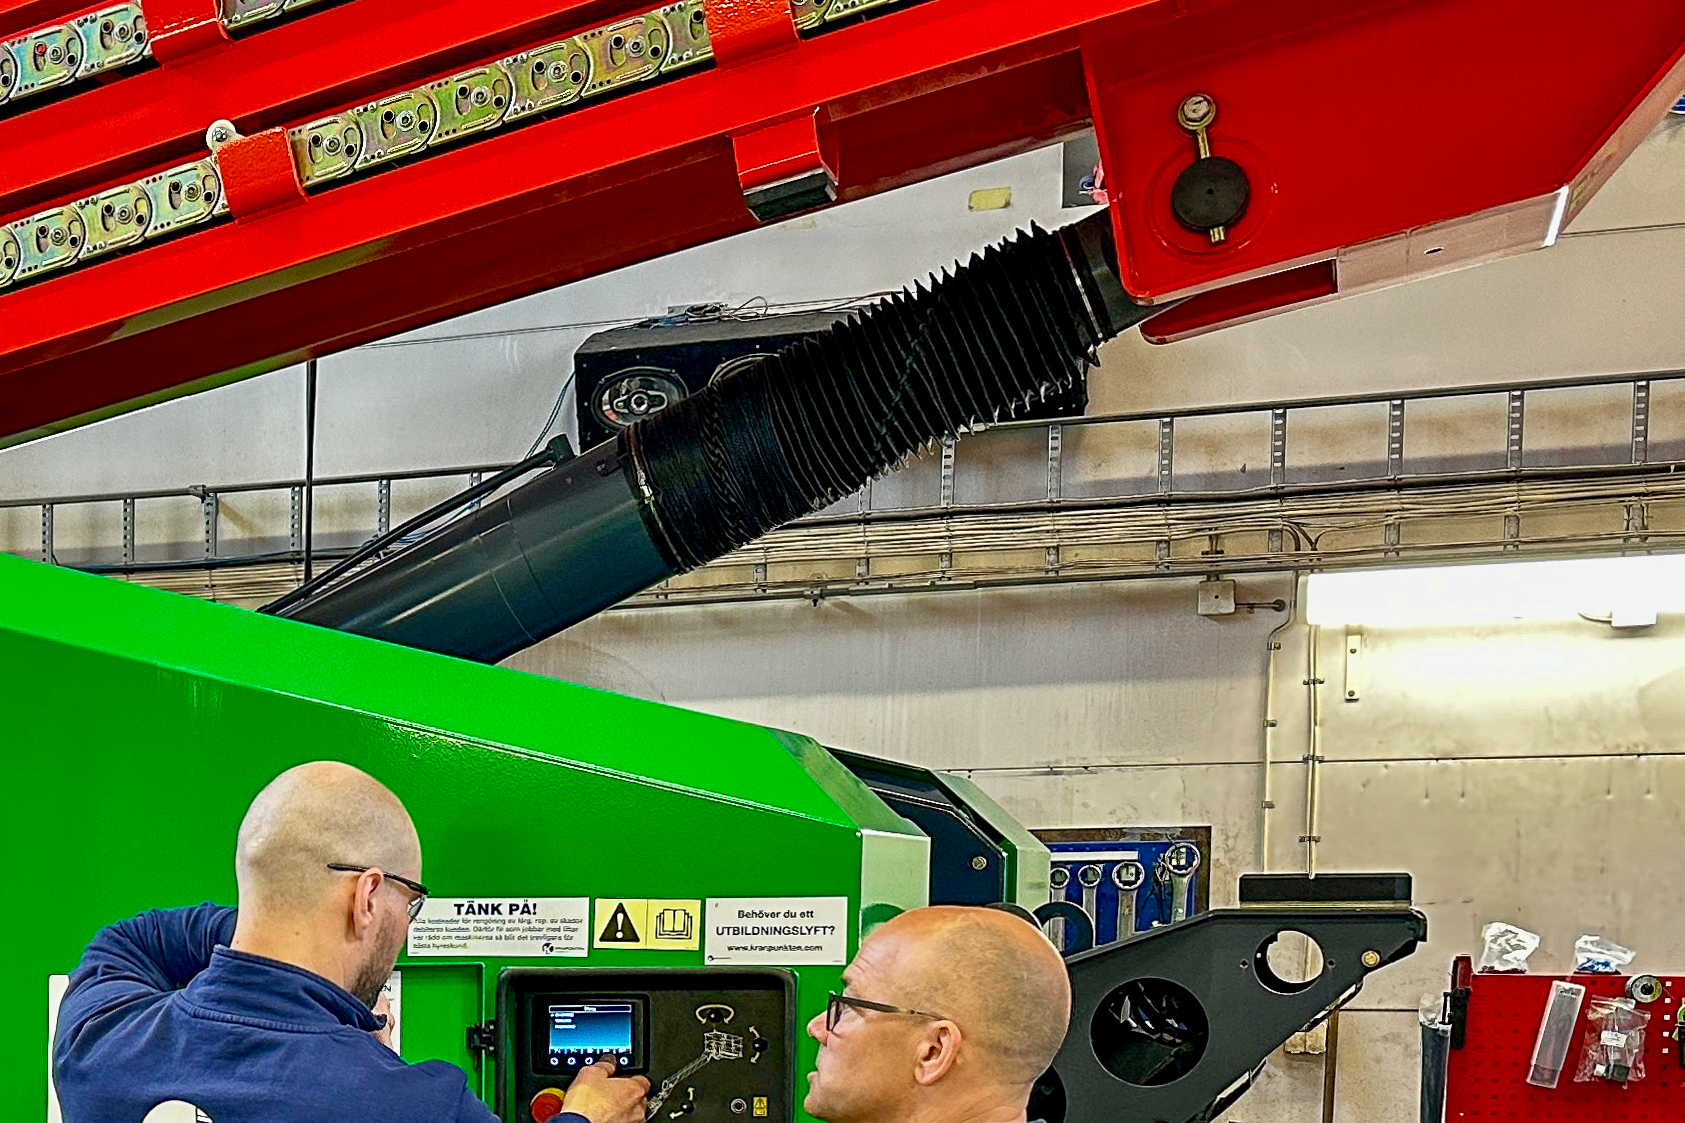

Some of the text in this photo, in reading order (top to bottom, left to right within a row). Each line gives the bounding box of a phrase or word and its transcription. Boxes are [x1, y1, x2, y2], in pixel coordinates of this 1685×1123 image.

[453, 899, 538, 916] TÄNK PÅ!
[737, 909, 815, 919] Behöver du ett
[715, 925, 836, 936] UTBILDNINGSLYFT?
